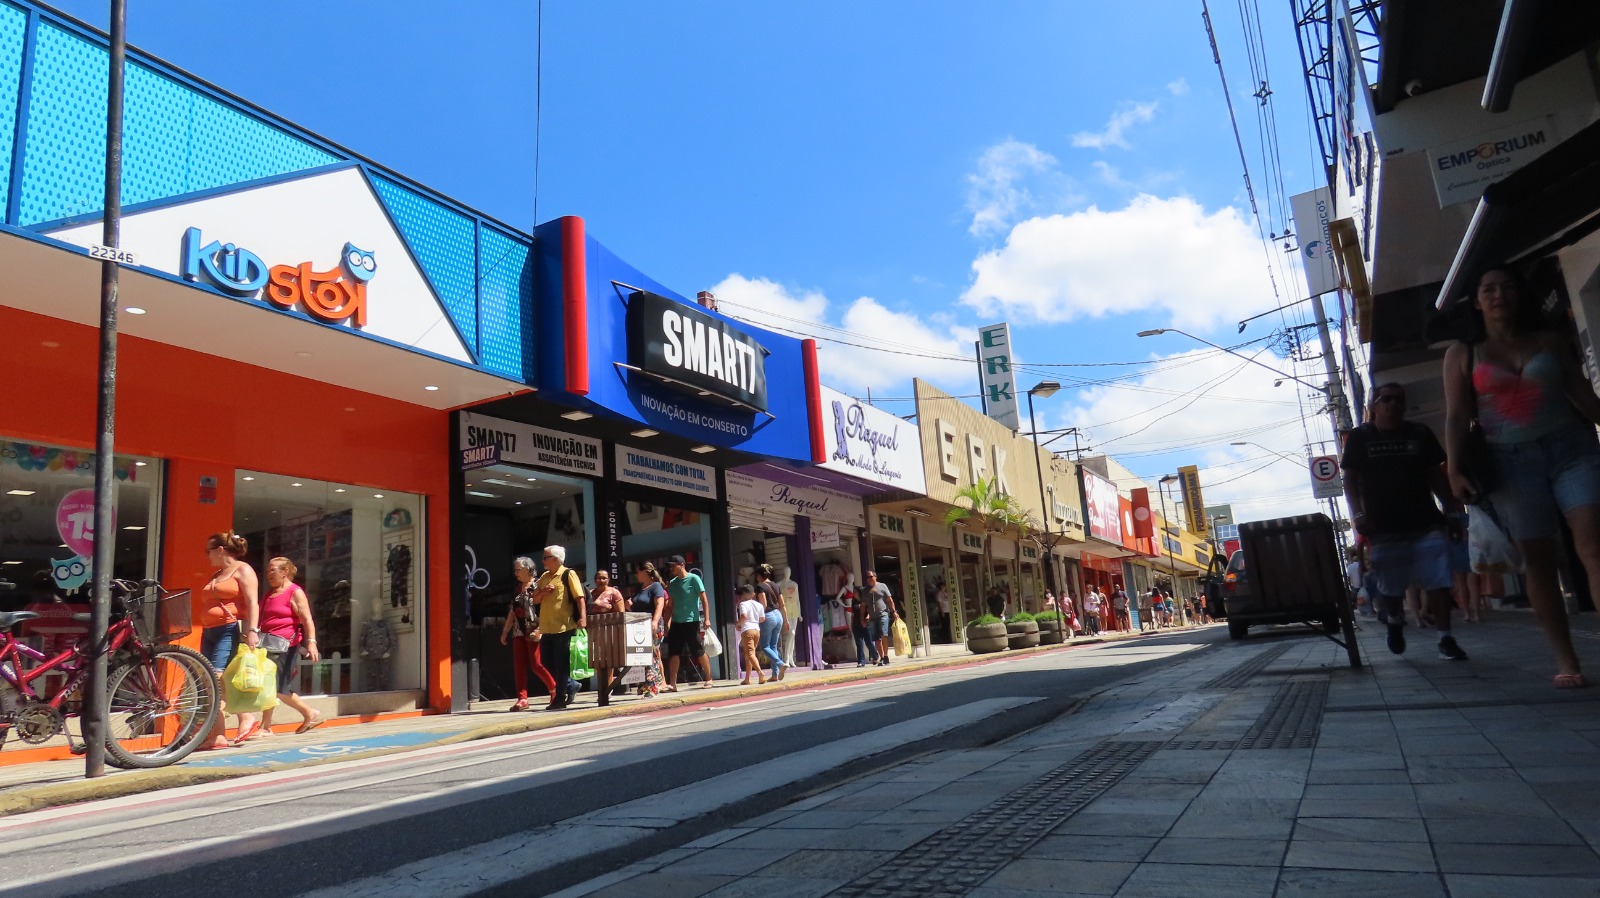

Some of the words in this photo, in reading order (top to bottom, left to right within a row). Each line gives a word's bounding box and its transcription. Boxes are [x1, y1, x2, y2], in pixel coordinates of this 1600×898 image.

[91, 246, 134, 264] 22346
[662, 309, 756, 394] SMART7
[982, 327, 1013, 403] ERK
[641, 393, 686, 421] INOVAÇÃO
[687, 411, 700, 425] EM
[701, 414, 748, 436] CONSERTO
[846, 403, 899, 456] Raquel
[463, 445, 495, 464] SMART7
[467, 425, 517, 453] SMART7
[532, 432, 582, 457] INOVAÇÃO
[584, 444, 598, 460] EM
[935, 417, 1012, 500] ERK
[627, 452, 674, 473] TRABALHAMOS
[675, 464, 689, 477] COM
[689, 468, 706, 480] TOTAL
[1319, 462, 1331, 476] E
[770, 483, 829, 513] Raquel
[608, 511, 618, 557] CONSERTA
[878, 513, 905, 533] ERK
[963, 533, 982, 549] ERK
[1022, 545, 1036, 558] ERK
[910, 584, 921, 641] MAGAZINE
[951, 588, 961, 639] MAGAZINE
